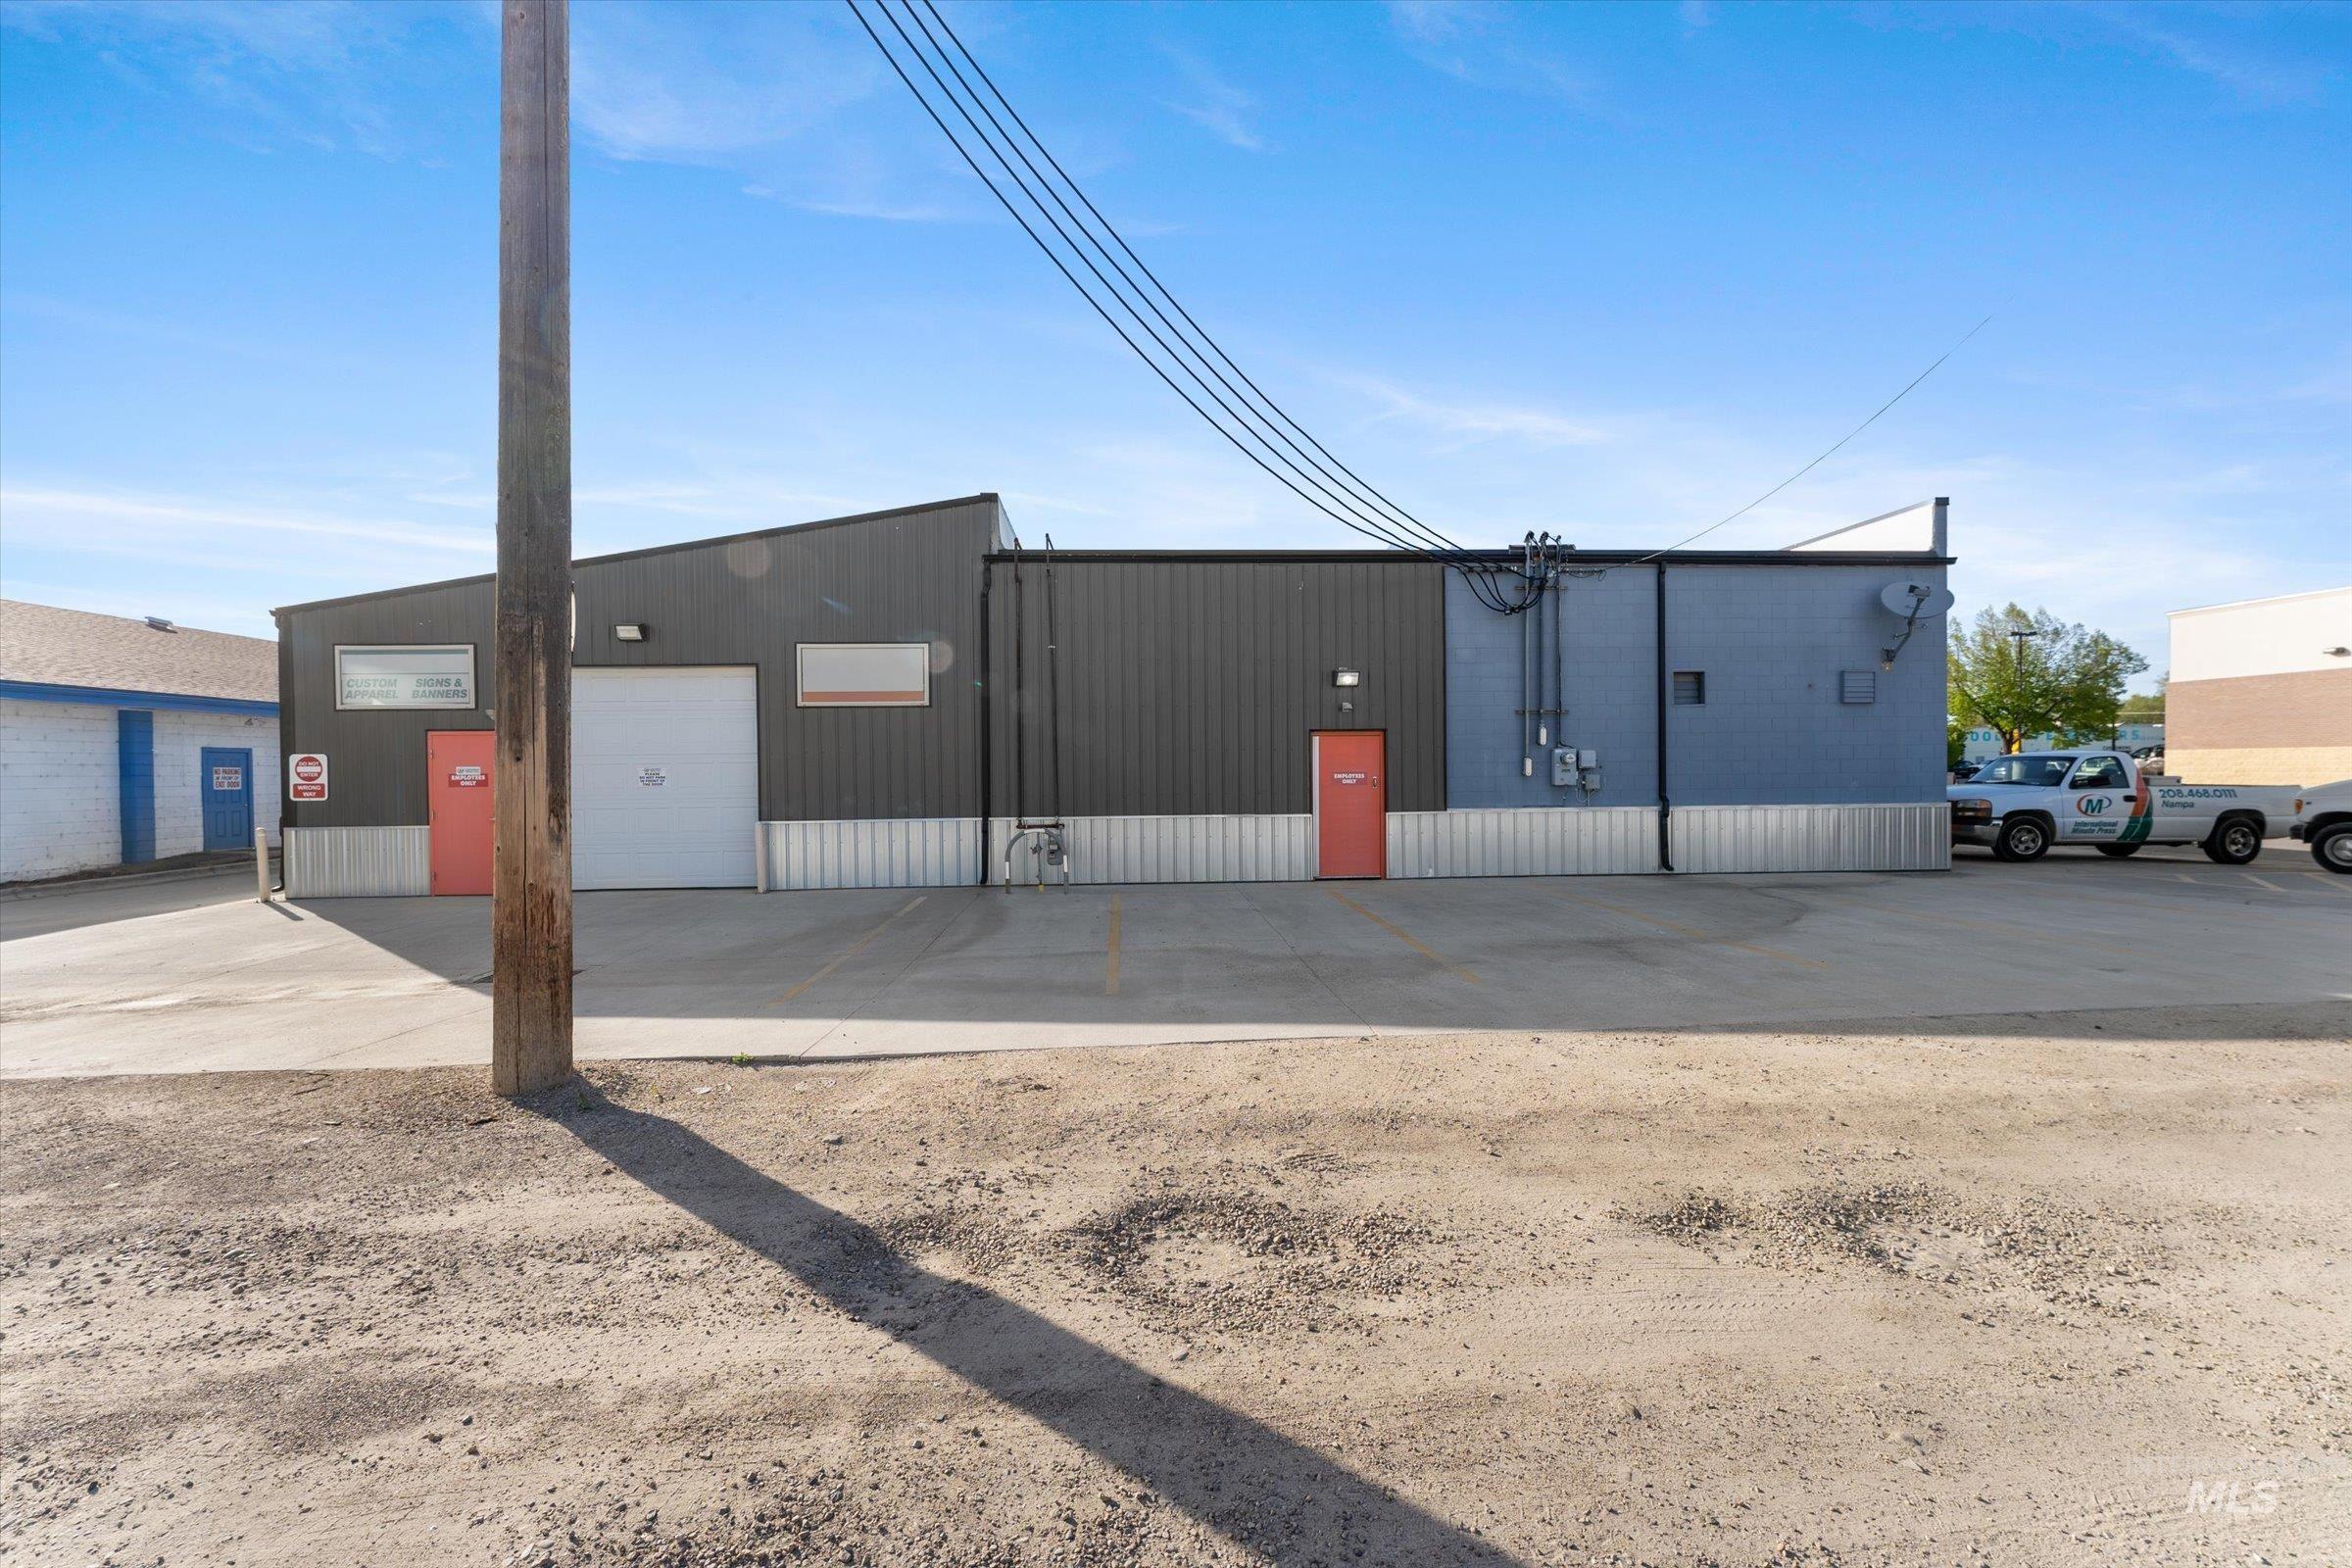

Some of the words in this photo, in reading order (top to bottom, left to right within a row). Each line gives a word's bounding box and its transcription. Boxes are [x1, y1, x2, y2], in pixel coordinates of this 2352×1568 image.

[346, 678, 398, 688] CUSTOM
[415, 678, 452, 688] SIGNS
[454, 678, 463, 687] &
[345, 689, 399, 699] APPAREL
[412, 689, 468, 699] BANNERS
[2159, 788, 2238, 799] 208.468.0111
[2161, 800, 2195, 808] Nampa
